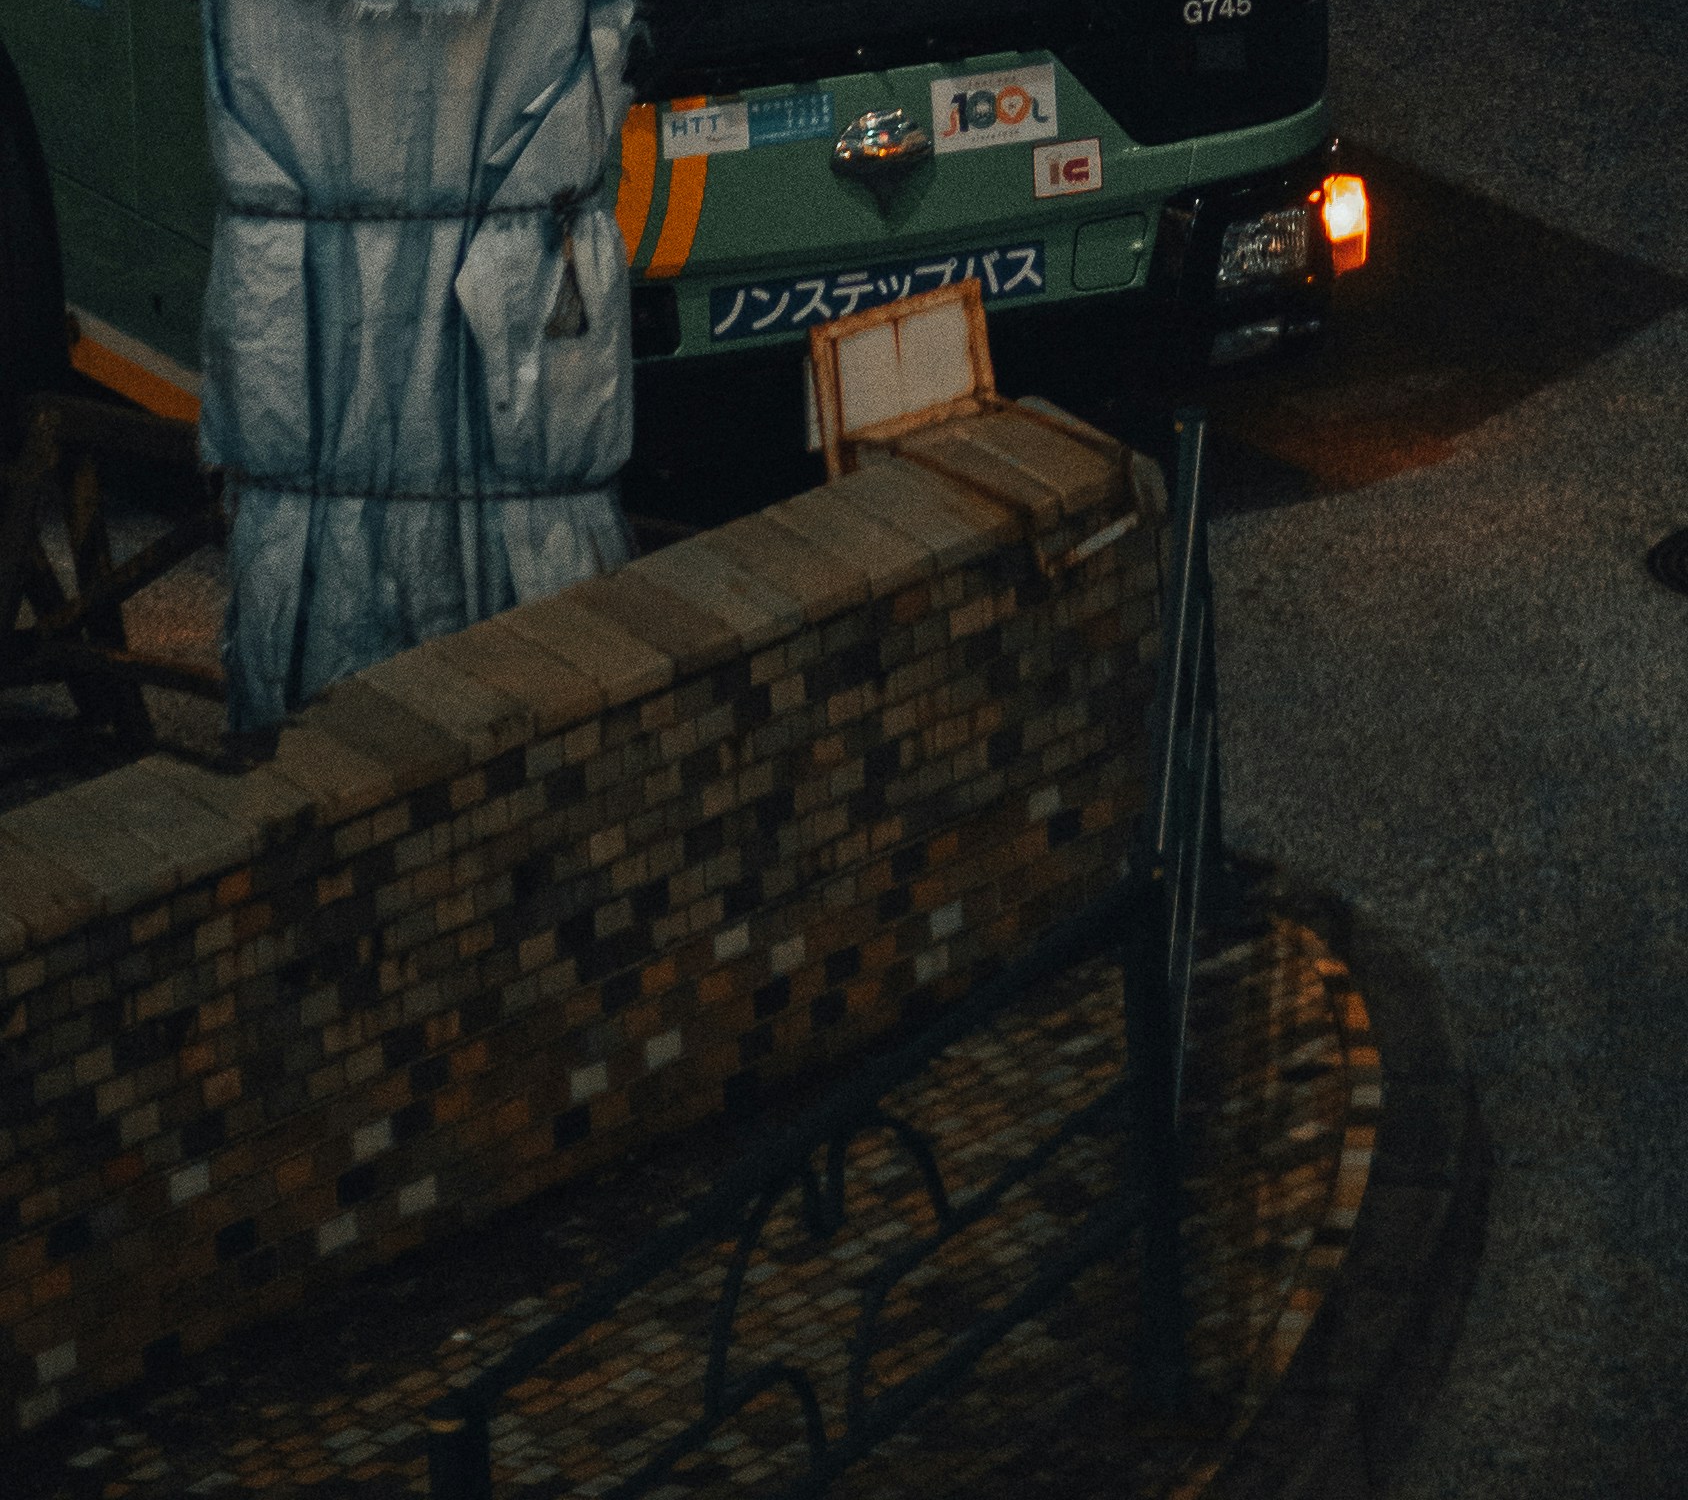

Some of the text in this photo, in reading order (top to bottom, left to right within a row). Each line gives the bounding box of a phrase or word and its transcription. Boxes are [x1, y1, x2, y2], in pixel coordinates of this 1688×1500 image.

[670, 113, 720, 138] HTT
[714, 248, 1043, 335] ノンステップバス
